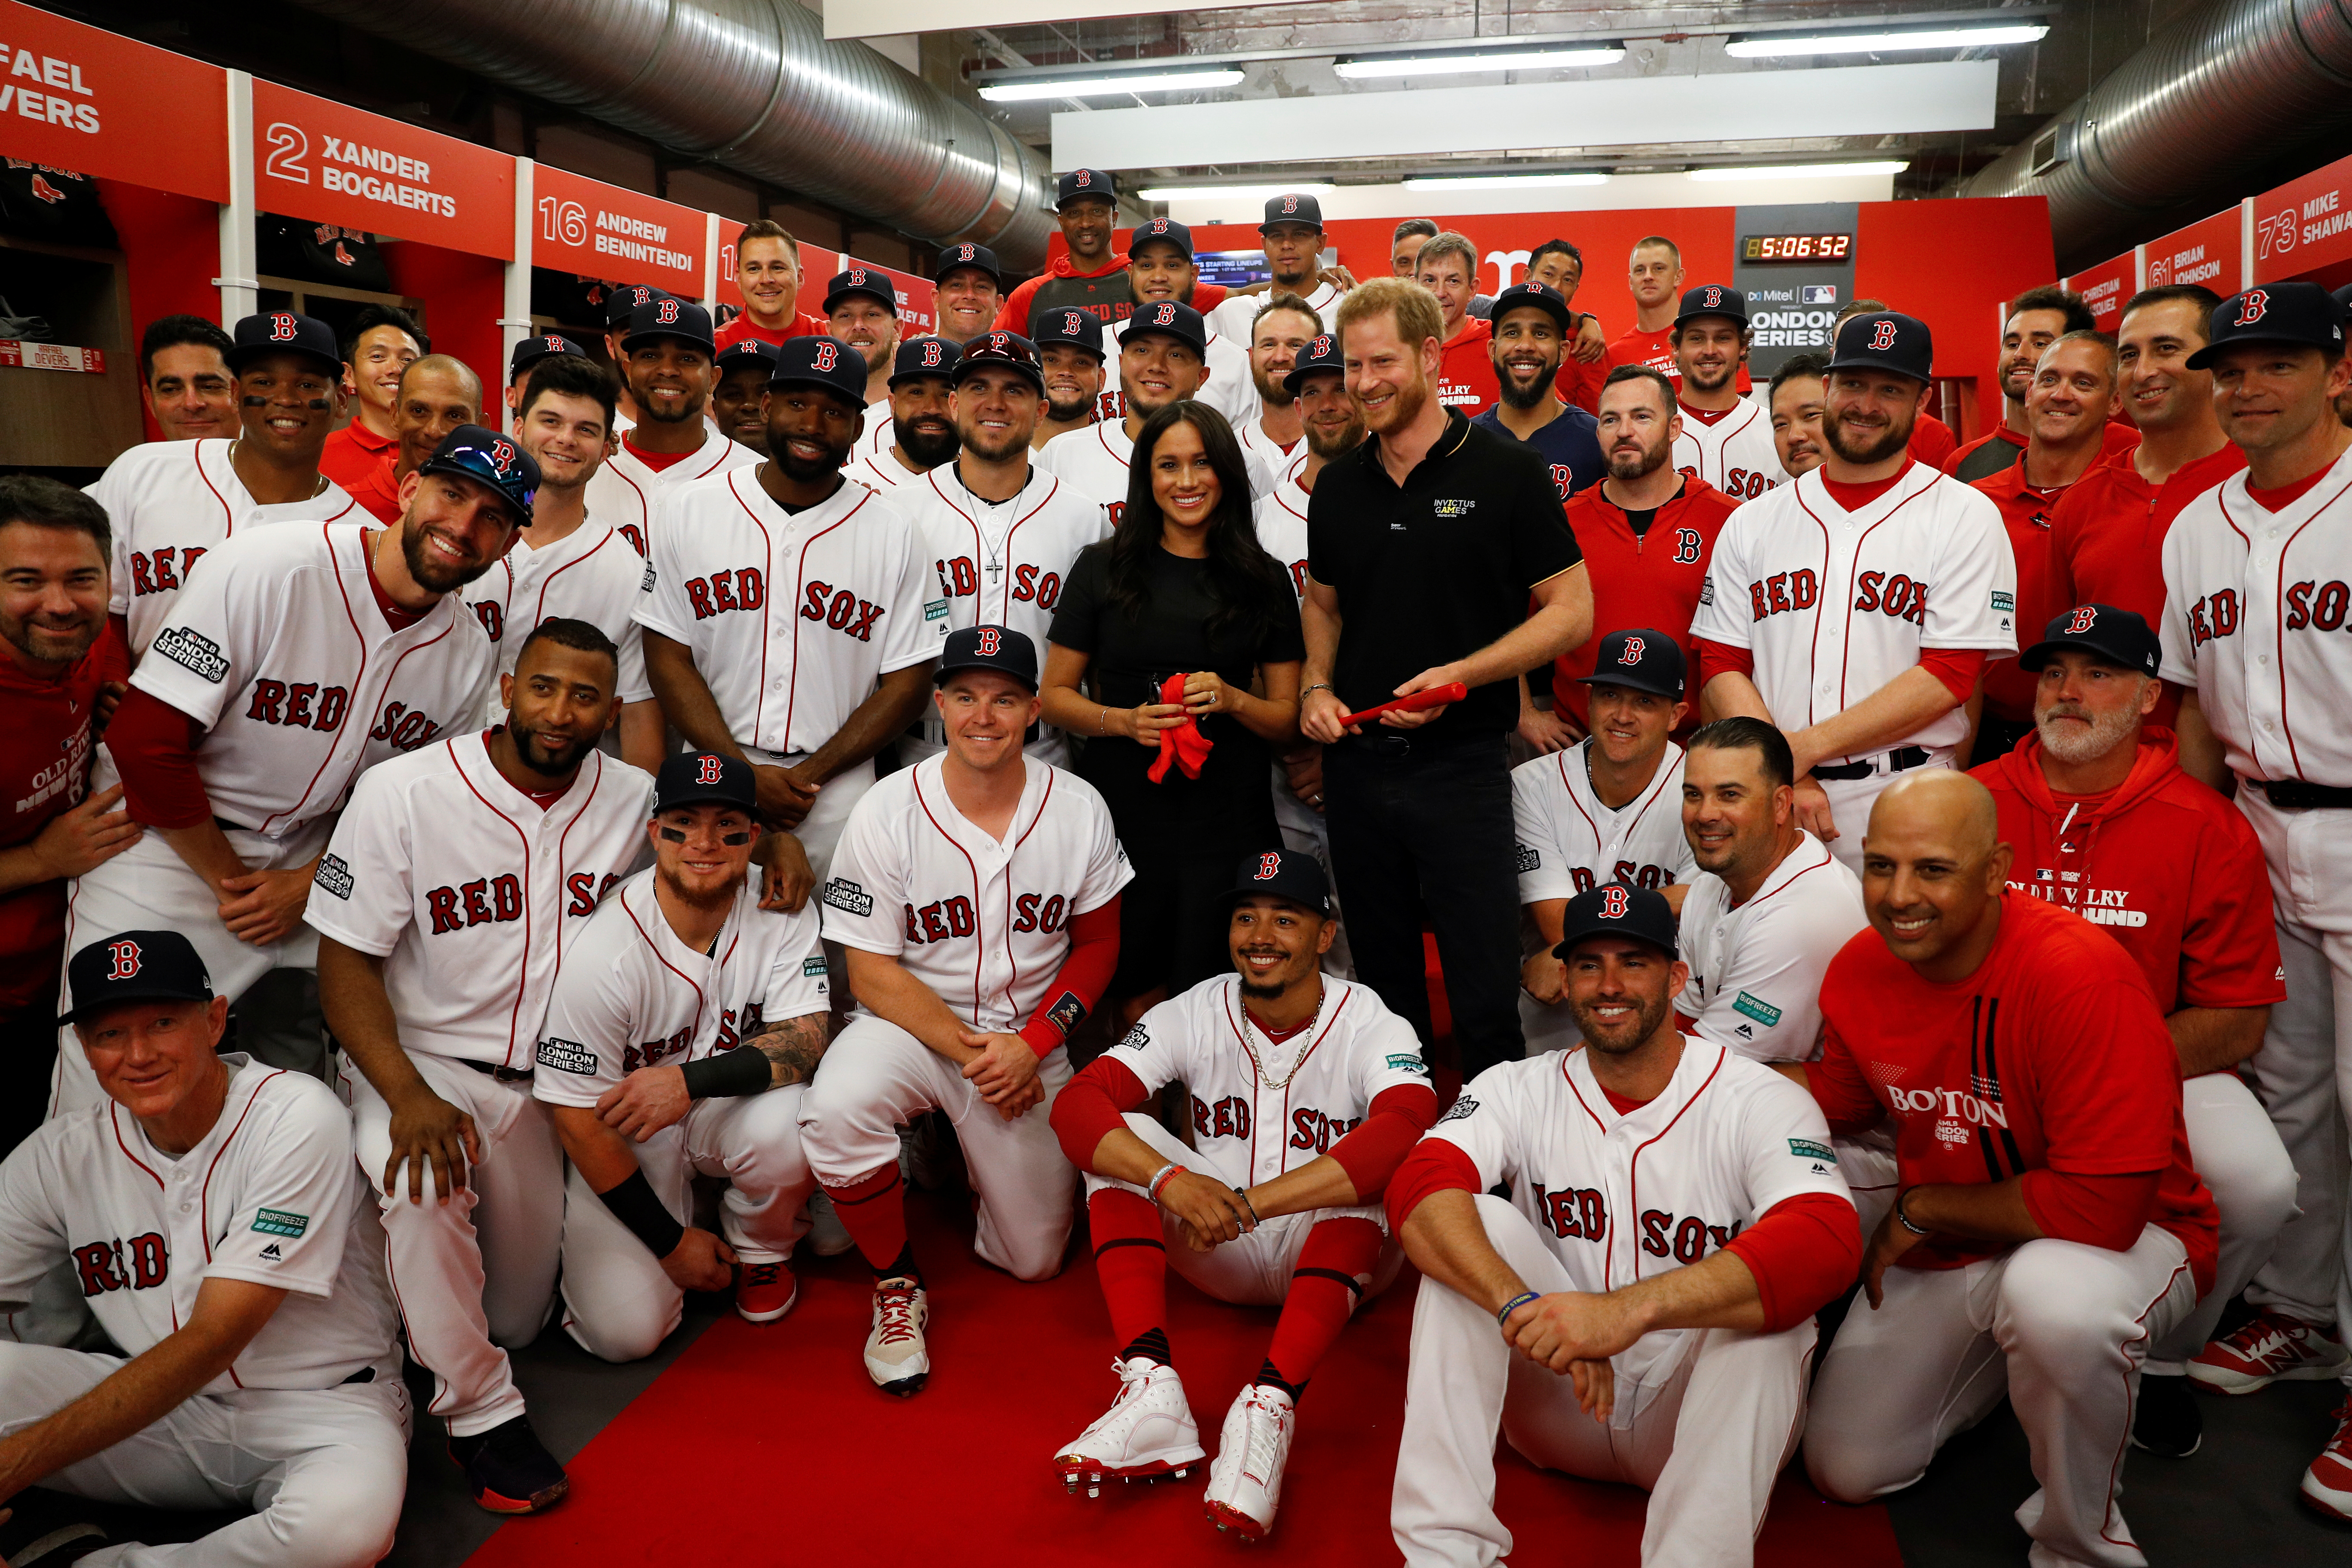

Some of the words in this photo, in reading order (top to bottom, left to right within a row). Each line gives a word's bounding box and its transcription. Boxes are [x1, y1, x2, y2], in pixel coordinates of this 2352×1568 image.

[266, 122, 308, 184] 2
[322, 135, 429, 184] XANDER
[323, 166, 456, 217] BOGAERTS
[1076, 170, 1092, 188] B
[1282, 194, 1298, 214] B
[2303, 190, 2339, 220] MIKE
[539, 196, 588, 247] 16
[595, 211, 666, 243] ANDREW
[1151, 218, 1169, 235] B
[2259, 208, 2297, 260] 73
[595, 234, 692, 273] BENINTENDI
[959, 244, 975, 261] B
[1761, 236, 1849, 257] 5:06:52
[2174, 244, 2205, 270] BRIAN
[722, 244, 738, 283] 1
[2149, 257, 2170, 288] 61
[2175, 260, 2220, 285] JOHNSON
[848, 268, 867, 287] B
[2083, 277, 2120, 303] CHRISTIAN
[632, 285, 650, 306] B
[1703, 286, 1722, 308] B
[1764, 289, 1794, 301] Mitel
[2234, 289, 2270, 326] B
[656, 298, 679, 324] B
[1062, 312, 1082, 335] B
[1153, 303, 1177, 325] B
[1748, 310, 1839, 329] ONDON
[270, 312, 298, 341] B
[1750, 329, 1825, 347] ERIES
[1868, 321, 1898, 350] B
[544, 335, 565, 352] B
[811, 340, 839, 372] B
[921, 341, 942, 367] B
[1311, 335, 1332, 360] B
[34, 352, 70, 367] DEVERS
[1438, 395, 1481, 406] OUND
[492, 438, 516, 475] B
[1549, 464, 1572, 500] B
[1434, 499, 1476, 508] INVICTUS
[1435, 506, 1467, 514] GAMES
[1673, 528, 1703, 564] B
[685, 567, 764, 620] RED
[801, 580, 885, 642] SOX
[1749, 568, 1818, 623] RED
[2064, 605, 2098, 634] B
[164, 629, 227, 673] LONDON
[196, 640, 217, 653] MLB
[974, 628, 1002, 656] B
[1618, 636, 1646, 665] B
[155, 638, 210, 674] SERIES
[211, 671, 220, 679] 19
[246, 678, 348, 732] RED
[32, 758, 67, 789] OLD
[695, 755, 723, 785] B
[15, 773, 67, 813] NEW
[319, 861, 352, 889] LONDON
[334, 859, 347, 872] MLB
[1254, 851, 1281, 880] B
[315, 869, 342, 894] SERIES
[826, 882, 869, 906] LONDON
[845, 882, 860, 892] MLB
[426, 873, 523, 935] RED
[824, 892, 861, 911] SERIES
[1598, 885, 1630, 919] B
[905, 894, 975, 945] RED
[107, 940, 143, 981] B
[540, 1044, 594, 1065] LONDON
[564, 1043, 582, 1053] MLB
[538, 1053, 583, 1072] SERIES
[1191, 1095, 1251, 1141] RED
[259, 1253, 282, 1262] Majestic
[1510, 1294, 1531, 1307] STRONG
